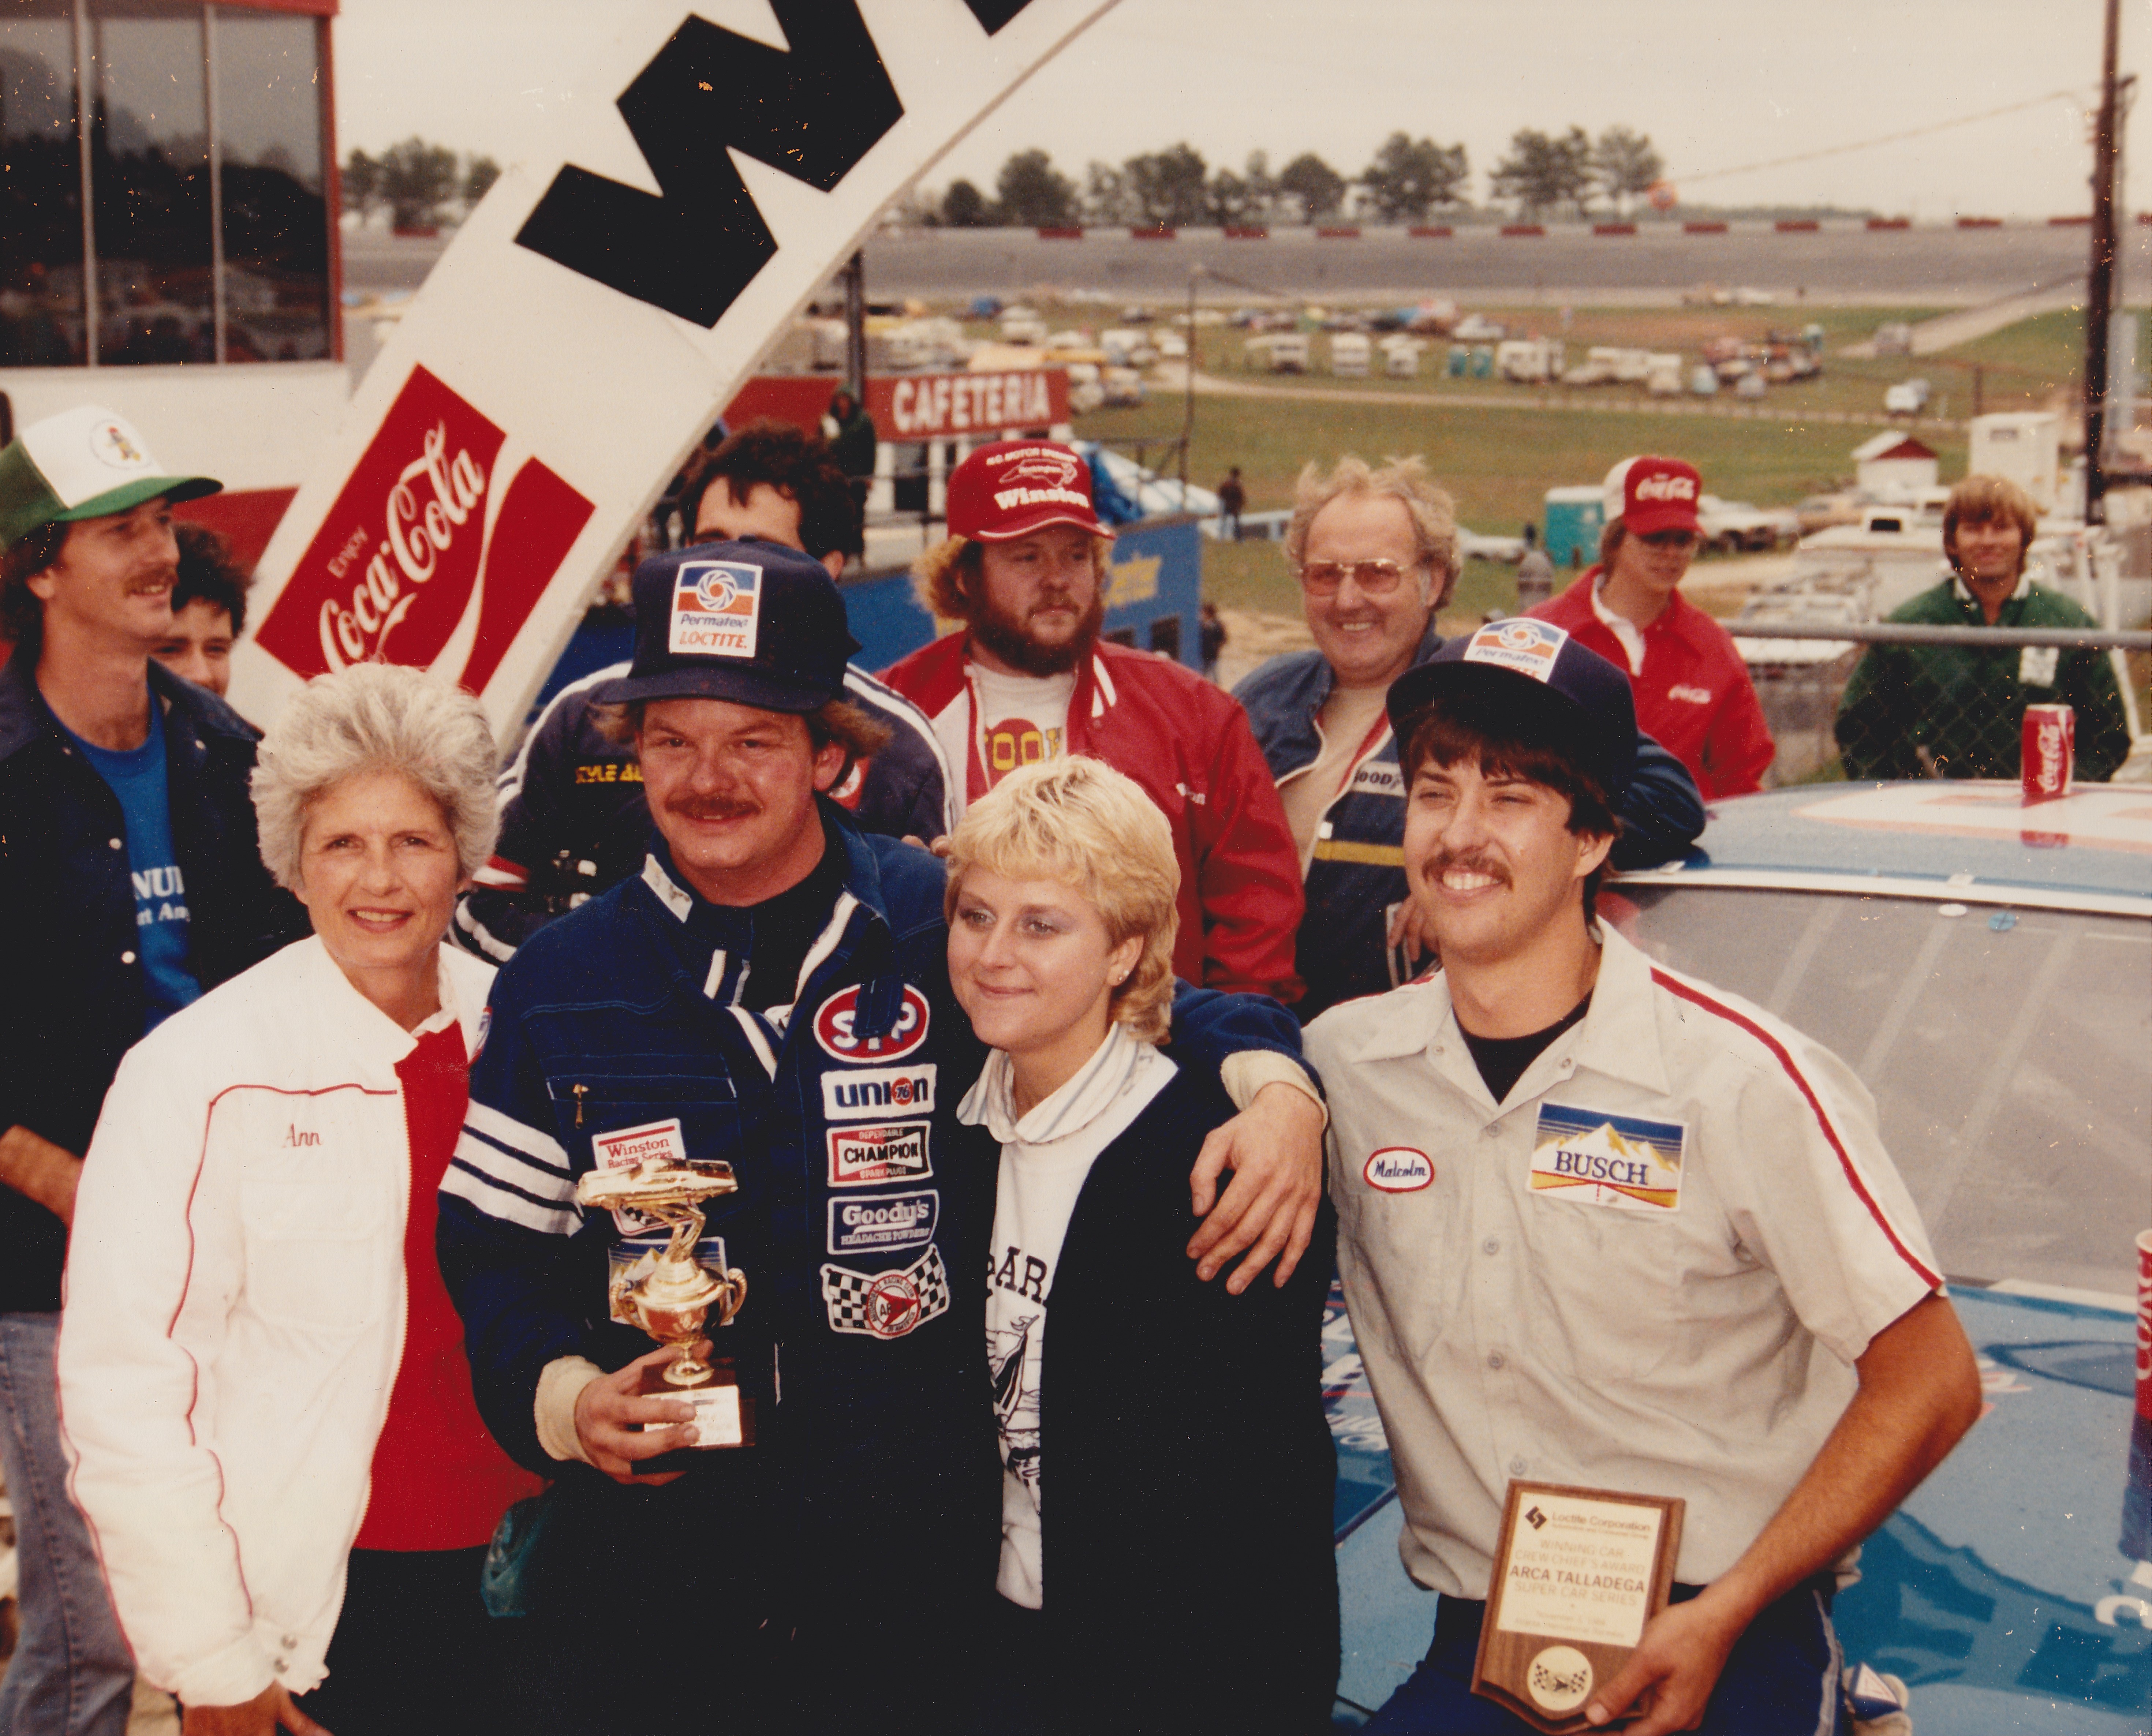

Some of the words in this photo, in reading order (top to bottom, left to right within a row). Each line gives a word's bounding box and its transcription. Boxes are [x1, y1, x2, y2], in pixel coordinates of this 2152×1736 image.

[514, 0, 1033, 329] W
[892, 374, 1050, 433] CAFETERIA
[994, 487, 1090, 510] Winston
[320, 420, 485, 674] Coca-Cola
[327, 525, 368, 579] Enjoy
[832, 1001, 917, 1050] SP
[282, 1123, 322, 1148] Ann
[859, 1128, 904, 1139] DEPENDABLE
[606, 1139, 670, 1158] Winston
[642, 1150, 673, 1160] Series
[844, 1142, 918, 1163] CHAMPION
[608, 1156, 640, 1169] Racing
[860, 1168, 886, 1178] SPARK
[886, 1166, 907, 1175] PLUGS
[1374, 1159, 1427, 1177] Malcolm
[1555, 1150, 1648, 1185] BUSCH
[843, 1199, 929, 1234] Goody's
[841, 1232, 892, 1245] HEADACHE
[892, 1227, 930, 1241] POWDERS
[1552, 1512, 1587, 1524] Loctite
[1589, 1516, 1651, 1531] Corporation
[1540, 1539, 1595, 1555] WINNING
[1599, 1546, 1624, 1558] CAR
[1515, 1549, 1549, 1562] CREW
[1599, 1560, 1645, 1574] AWARD
[1509, 1564, 1550, 1581] ARCA
[1556, 1569, 1645, 1593] TALLADEGA
[1514, 1581, 1557, 1596] SUPER
[1561, 1586, 1587, 1600] CAR
[1591, 1591, 1637, 1606] SERIES
